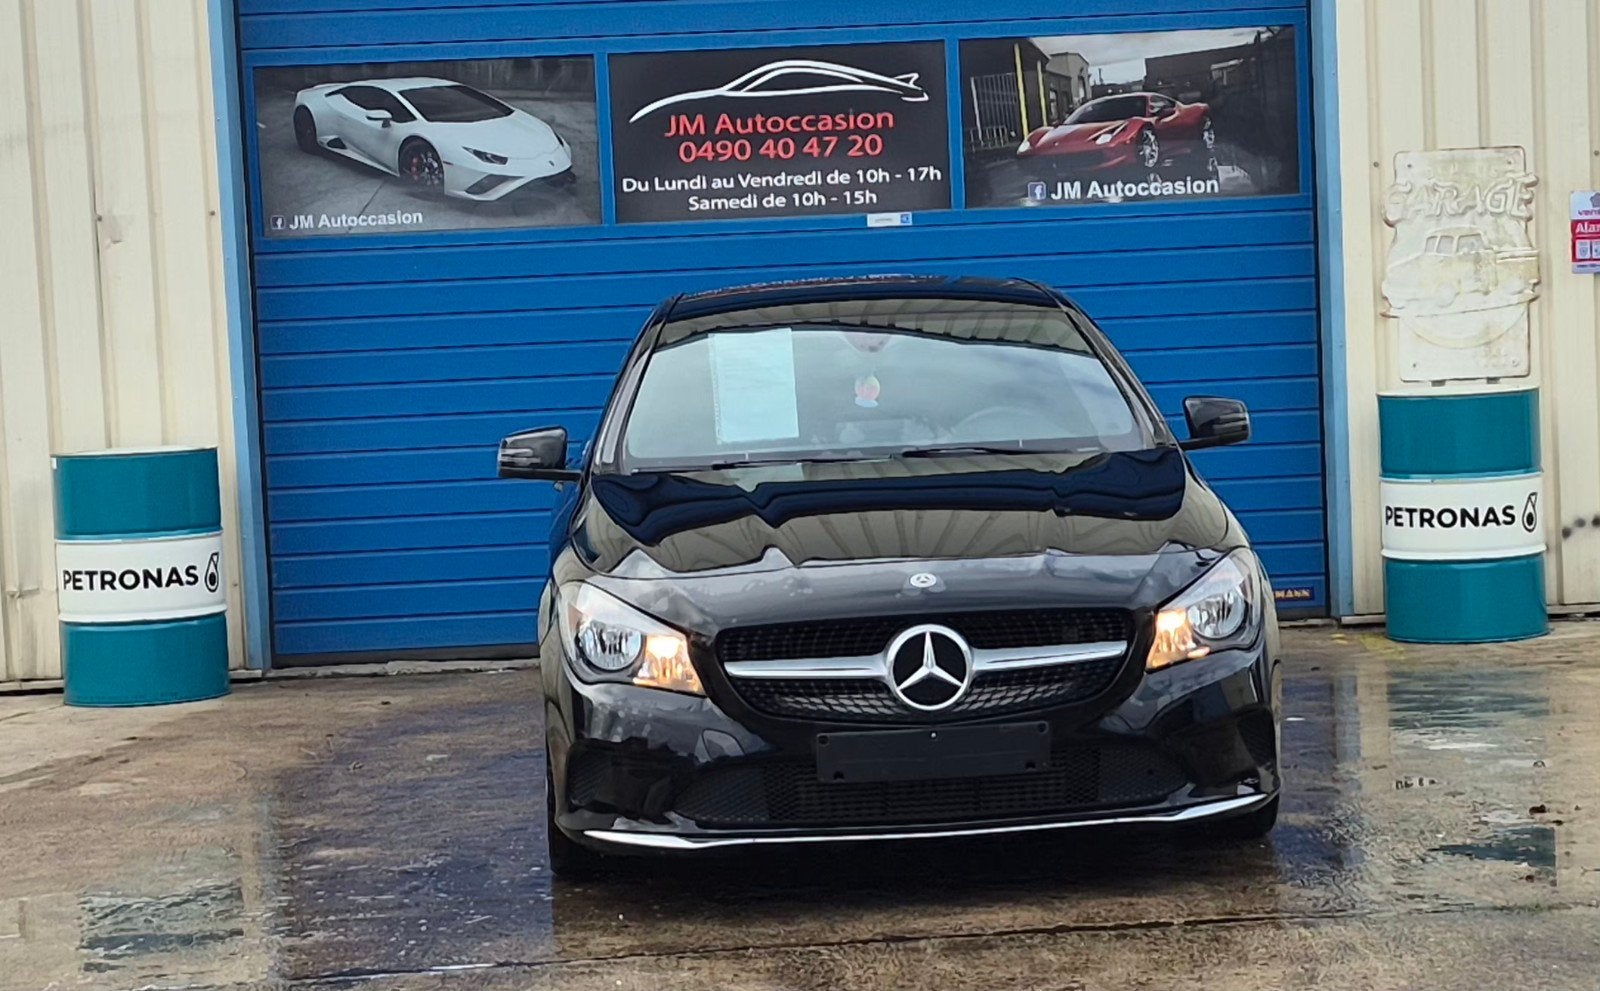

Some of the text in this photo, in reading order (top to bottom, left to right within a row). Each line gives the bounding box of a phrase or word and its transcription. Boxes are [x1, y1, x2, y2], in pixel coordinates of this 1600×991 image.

[664, 109, 894, 137] JM Autoccasion
[678, 134, 884, 163] 0490 40 47 20
[622, 178, 649, 192] Du
[654, 174, 707, 191] Lundi
[711, 177, 734, 189] au
[737, 170, 822, 188] Vendredi
[826, 169, 851, 185] de
[857, 168, 890, 184] 10h
[907, 165, 942, 182] 17h
[1050, 181, 1082, 200] JM
[1086, 176, 1220, 198] Autoccasion
[688, 193, 758, 211] Samedi
[762, 193, 787, 208] de
[792, 190, 826, 207] 10h
[843, 189, 877, 205] 15h
[1382, 174, 1539, 227] GARAGE
[289, 214, 314, 230] JM
[318, 210, 423, 228] Autoccasion
[1385, 505, 1516, 528] PETRONAS
[63, 565, 199, 590] PETRONAS
